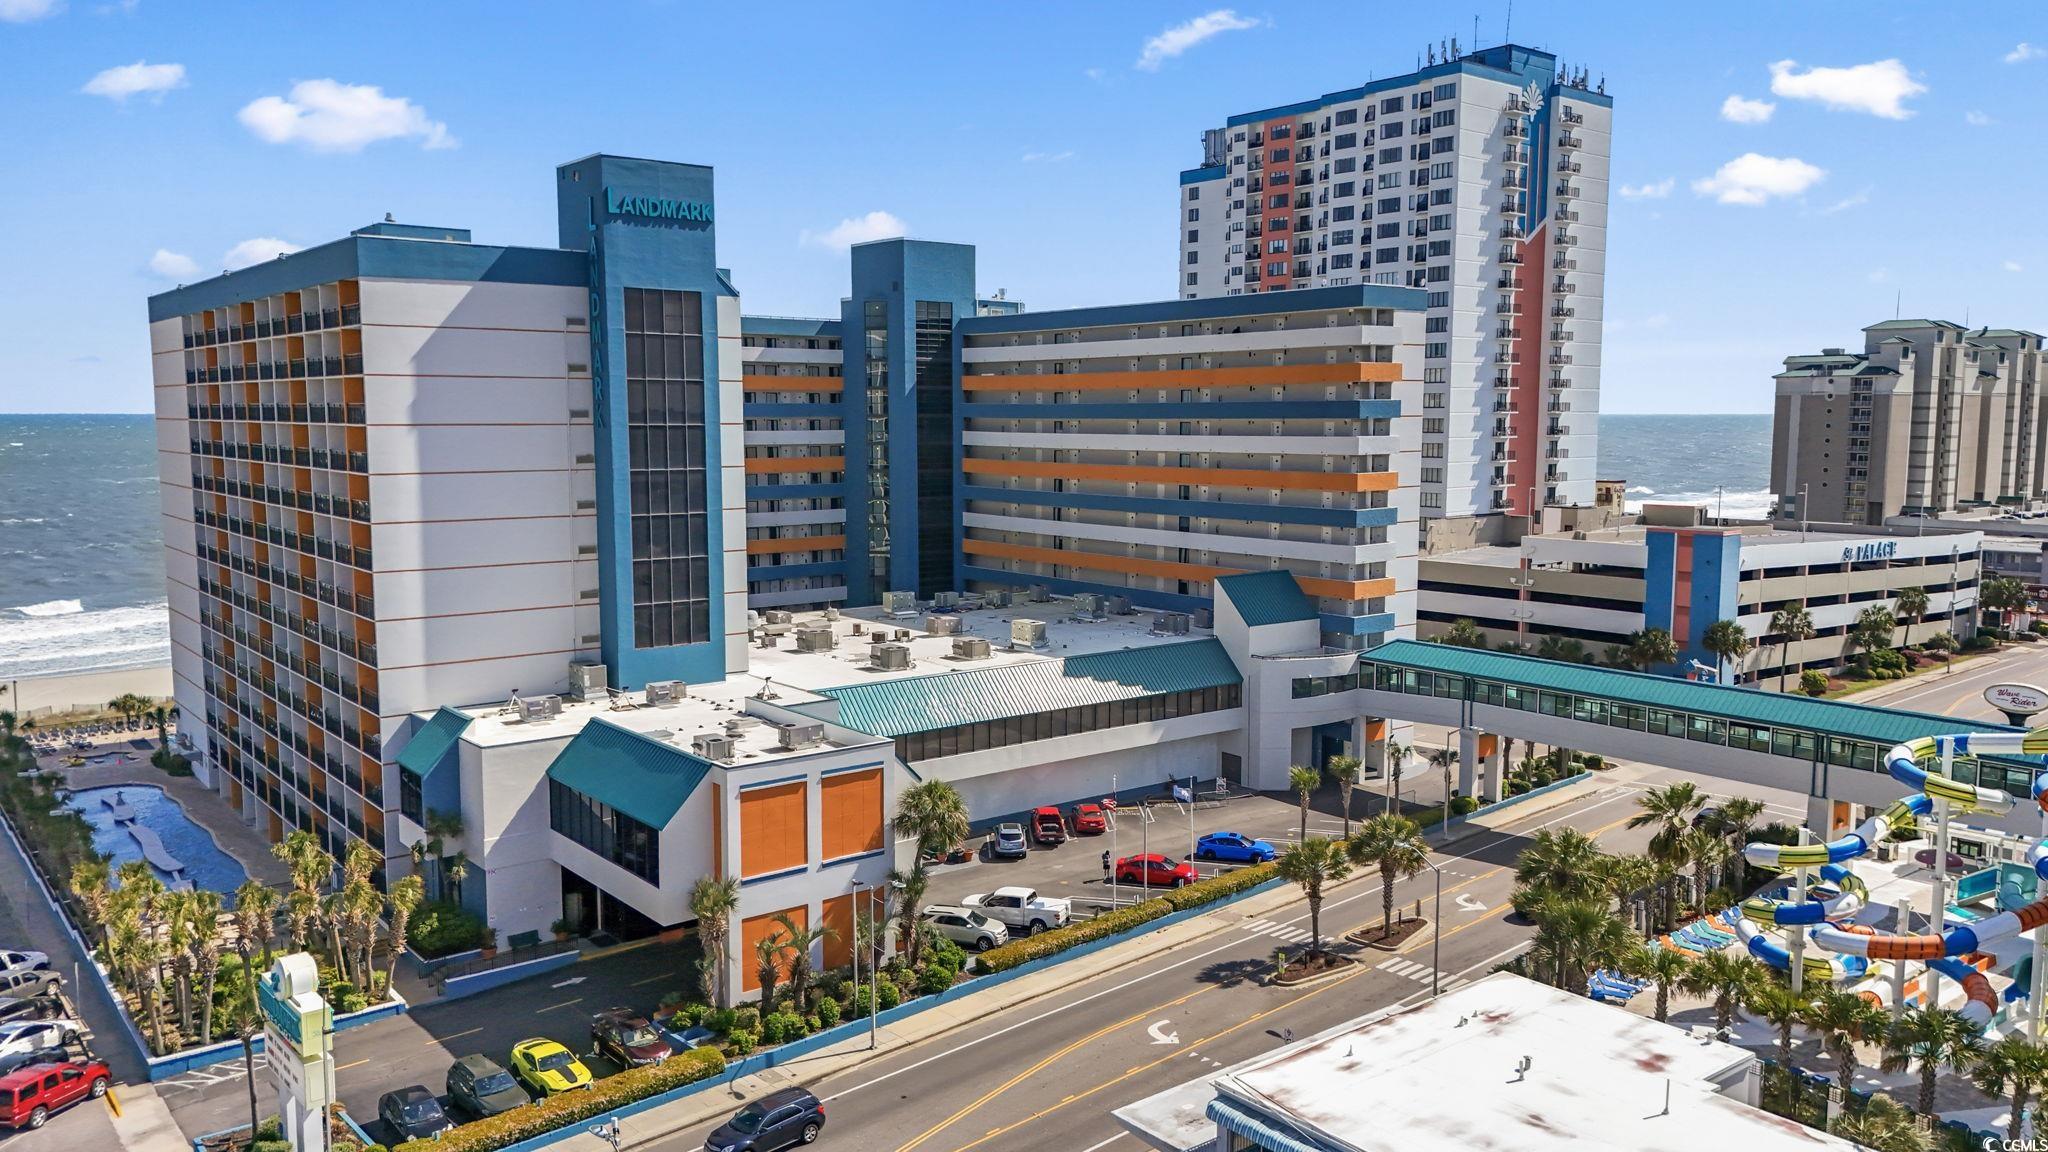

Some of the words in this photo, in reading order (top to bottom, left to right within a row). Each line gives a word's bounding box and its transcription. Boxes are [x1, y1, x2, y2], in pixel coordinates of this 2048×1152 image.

[607, 186, 713, 222] LANDMARK
[587, 196, 604, 428] LANDMARK
[1857, 541, 1897, 561] PALACE
[1997, 689, 2020, 697] Wave
[2010, 697, 2037, 706] Rider
